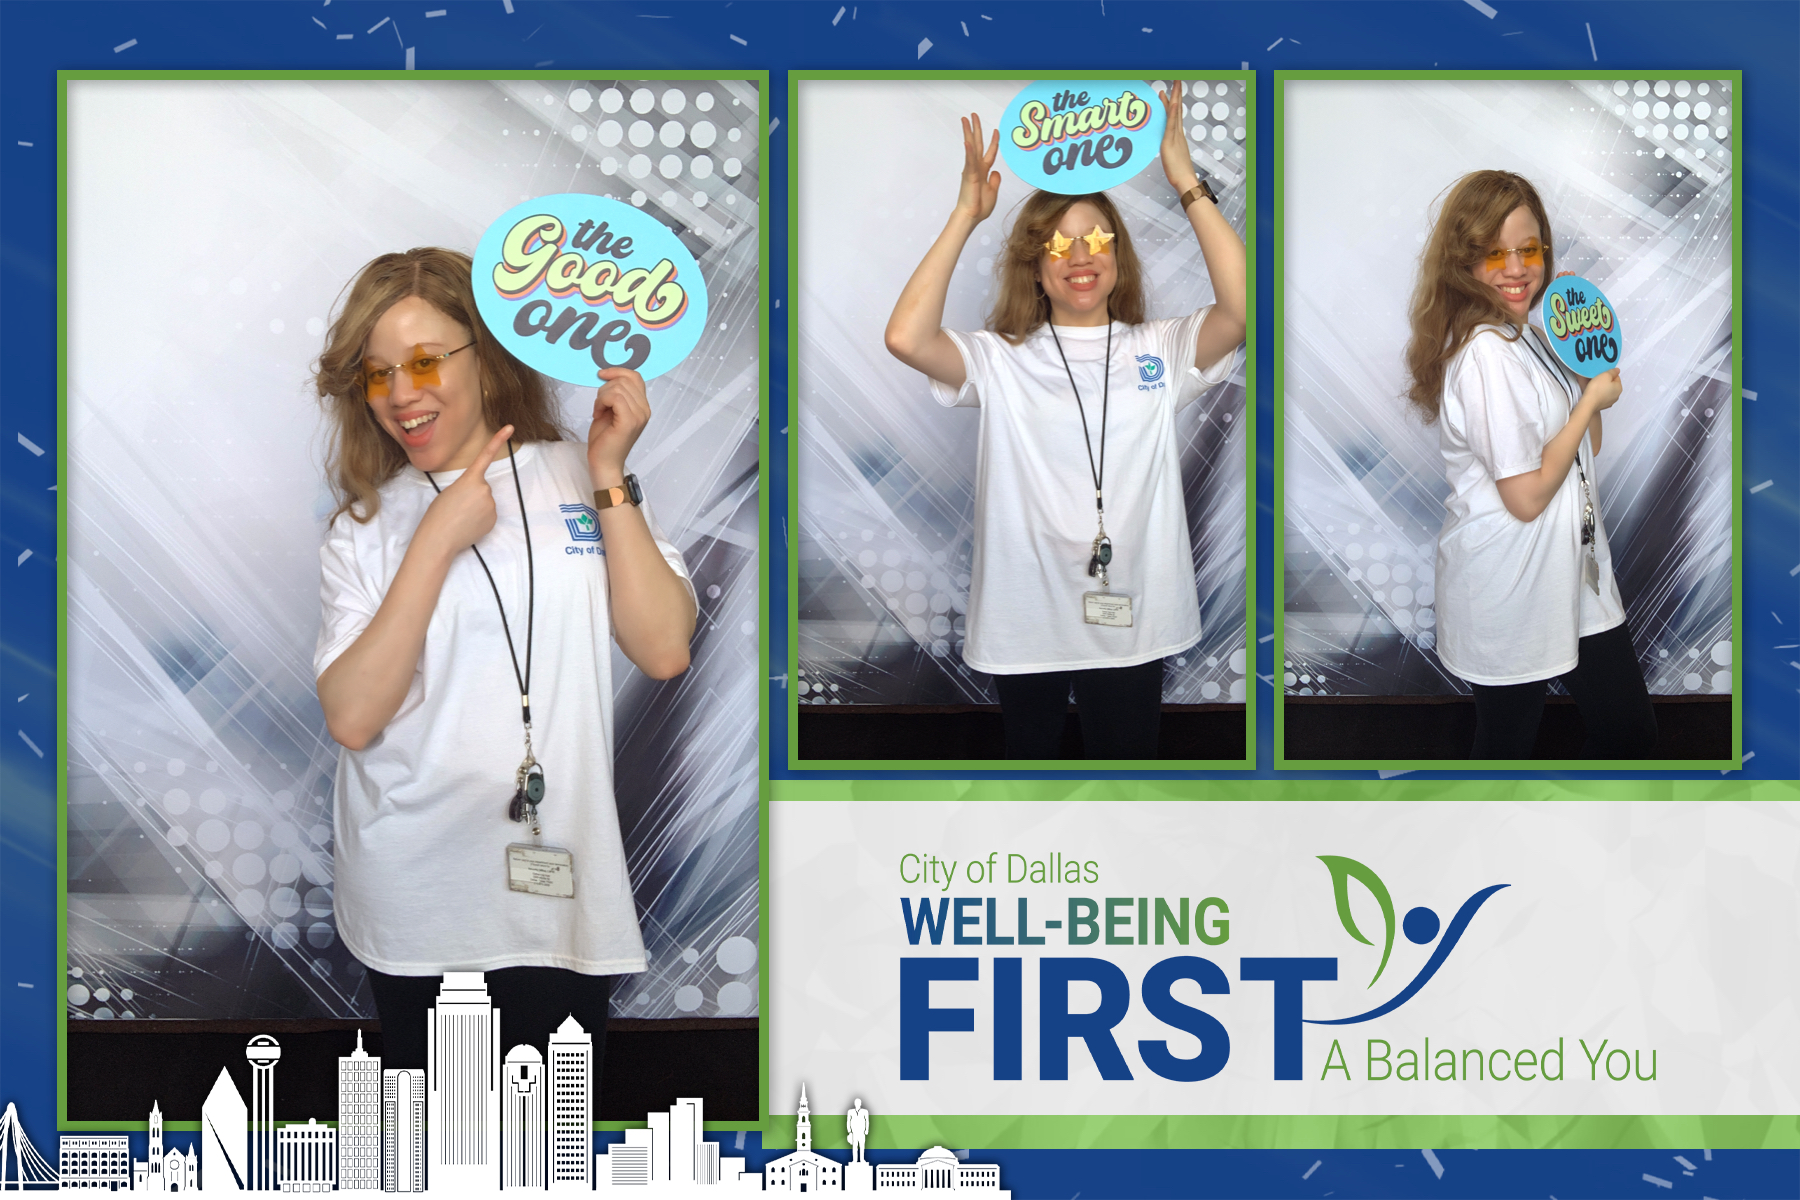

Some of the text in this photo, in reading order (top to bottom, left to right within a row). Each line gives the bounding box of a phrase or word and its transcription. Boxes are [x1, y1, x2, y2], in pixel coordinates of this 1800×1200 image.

[1011, 90, 1152, 152] Smart
[1052, 89, 1091, 112] the
[1042, 134, 1133, 175] one
[571, 218, 635, 259] the
[492, 213, 689, 331] Good
[1549, 292, 1614, 341] Sweet
[1566, 287, 1586, 306] the
[513, 299, 651, 371] one
[1575, 333, 1618, 363] one
[565, 546, 584, 556] City
[586, 546, 595, 554] of
